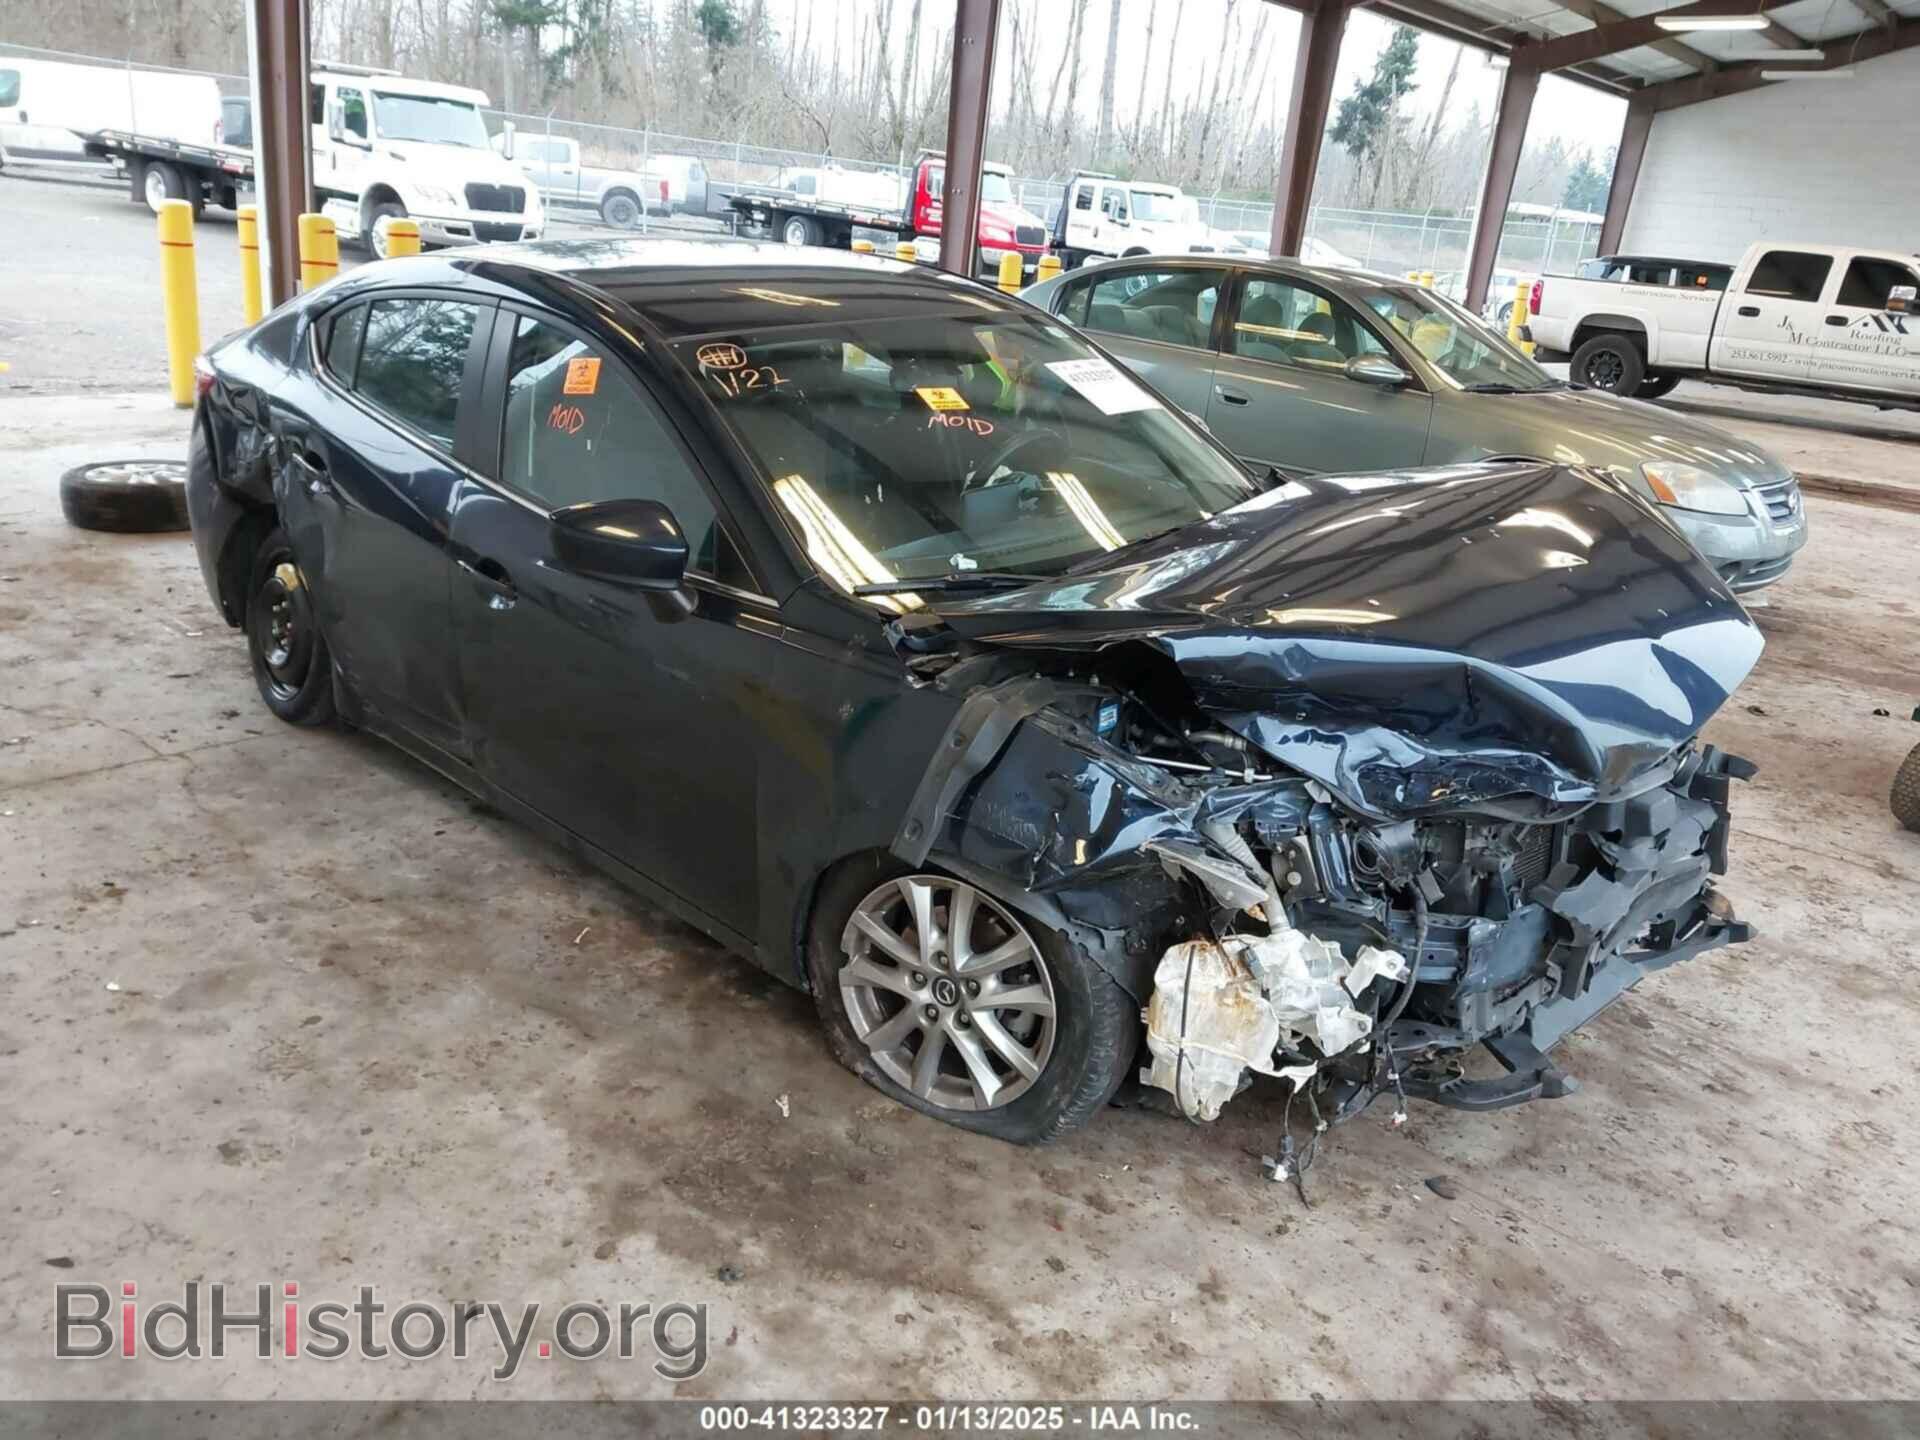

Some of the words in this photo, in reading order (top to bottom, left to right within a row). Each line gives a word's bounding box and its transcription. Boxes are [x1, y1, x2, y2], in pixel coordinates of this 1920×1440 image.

[1850, 328, 1902, 346] Roofing
[1806, 337, 1872, 354] Contractor
[1874, 343, 1908, 358] LLC
